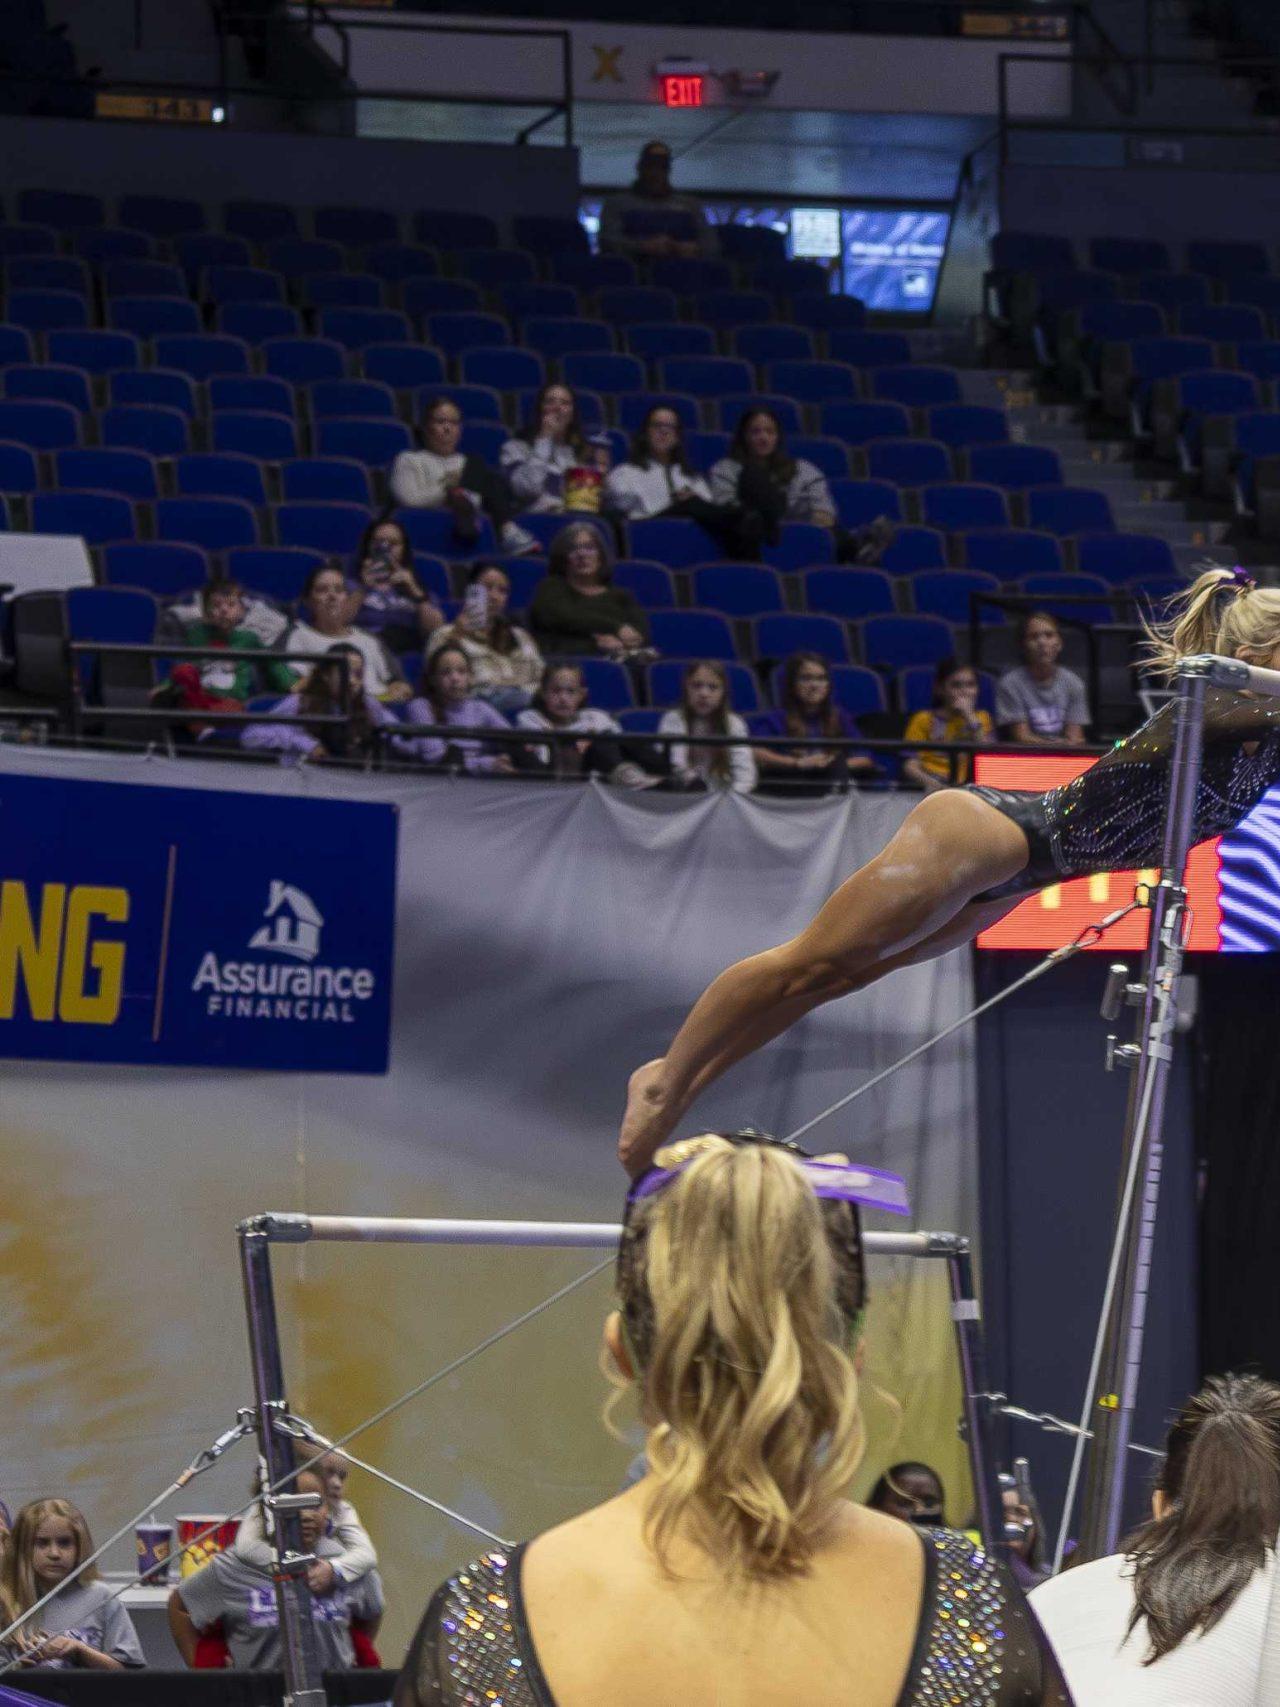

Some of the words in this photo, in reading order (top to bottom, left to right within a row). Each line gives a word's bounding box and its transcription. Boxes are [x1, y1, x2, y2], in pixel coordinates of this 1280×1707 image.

[666, 77, 703, 107] EXIT
[191, 952, 376, 1001] Assurance
[206, 996, 356, 1023] FINANCIAL
